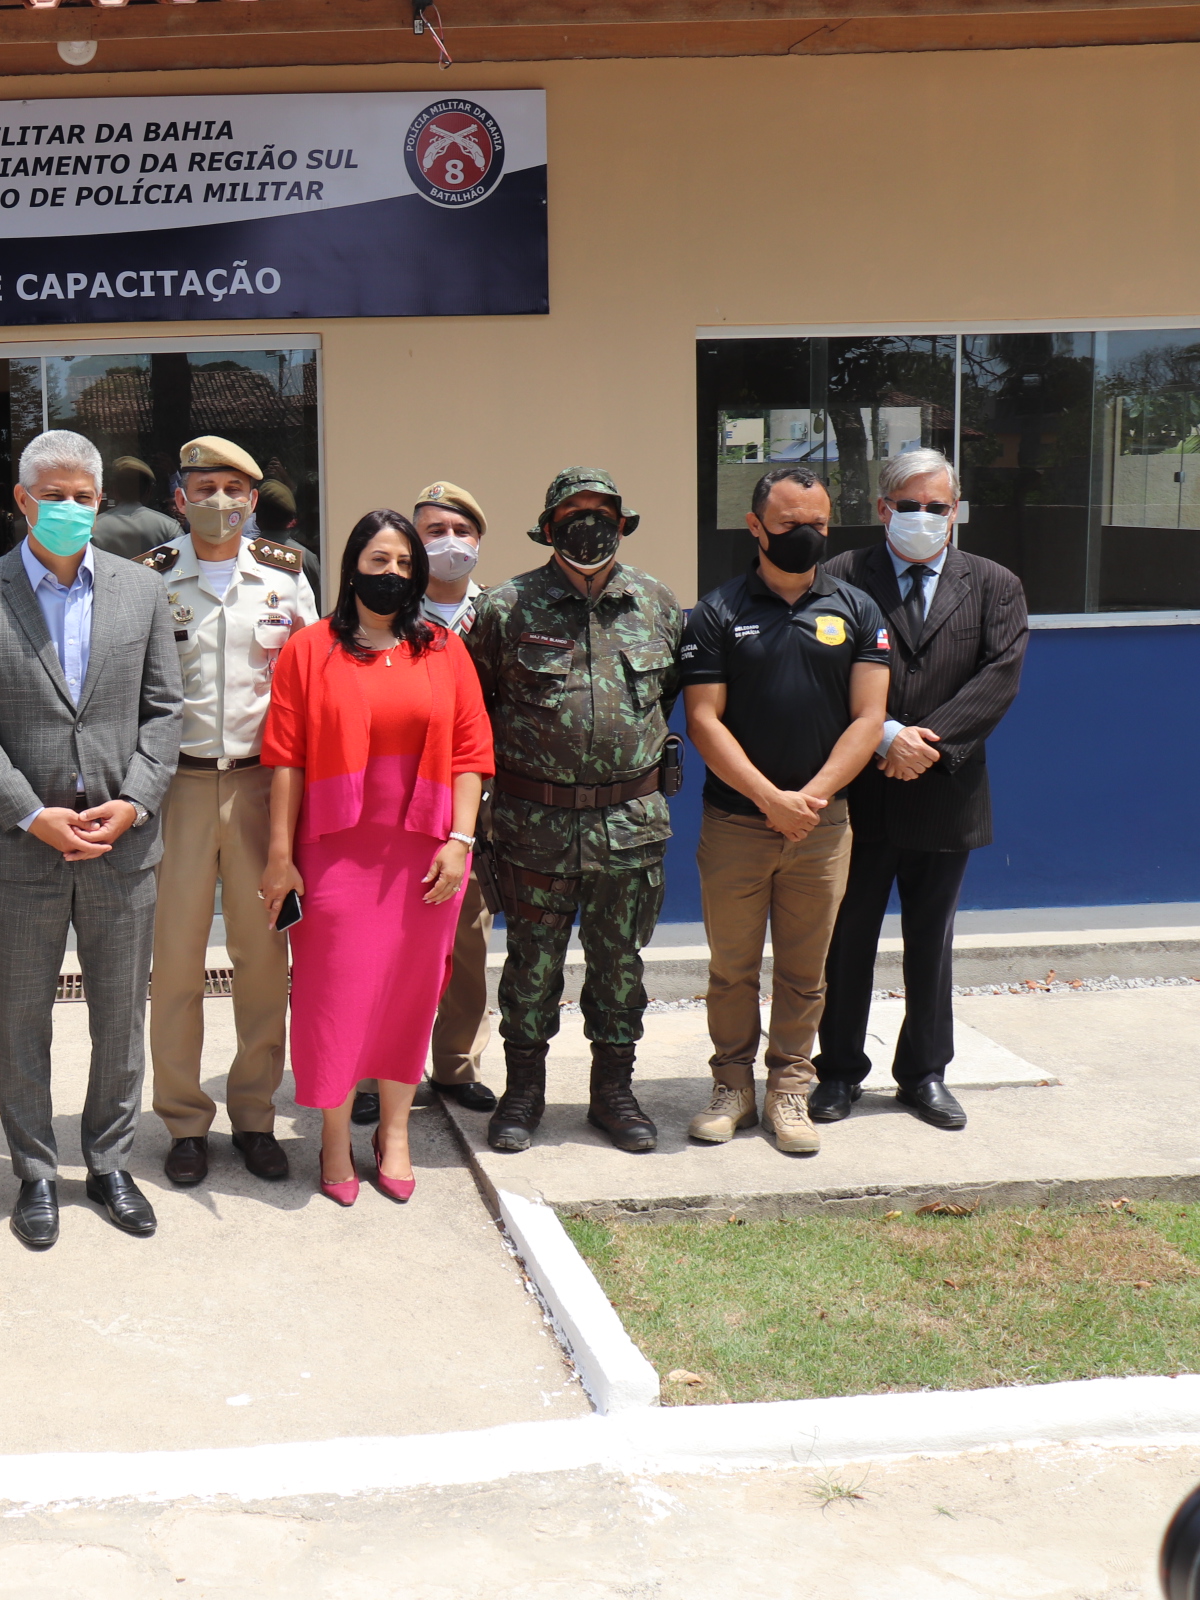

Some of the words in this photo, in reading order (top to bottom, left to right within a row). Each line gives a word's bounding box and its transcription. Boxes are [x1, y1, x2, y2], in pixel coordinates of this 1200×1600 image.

[94, 123, 133, 144] DA
[143, 120, 234, 142] BAHIA
[406, 113, 430, 151] POLÍCIA
[429, 101, 472, 115] MILITAR
[473, 107, 486, 121] DA
[485, 120, 502, 151] BAHIA
[139, 152, 178, 174] DA
[187, 144, 298, 172] REGIÃO
[306, 149, 359, 170] SUL
[444, 159, 465, 185] 8
[29, 186, 67, 208] DE
[75, 178, 193, 207] POLÍCIA
[203, 179, 324, 203] MILITAR
[429, 186, 485, 202] BATALHÃO
[16, 260, 281, 302] CAPACITAÇÃO
[734, 624, 760, 632] DELEGADO
